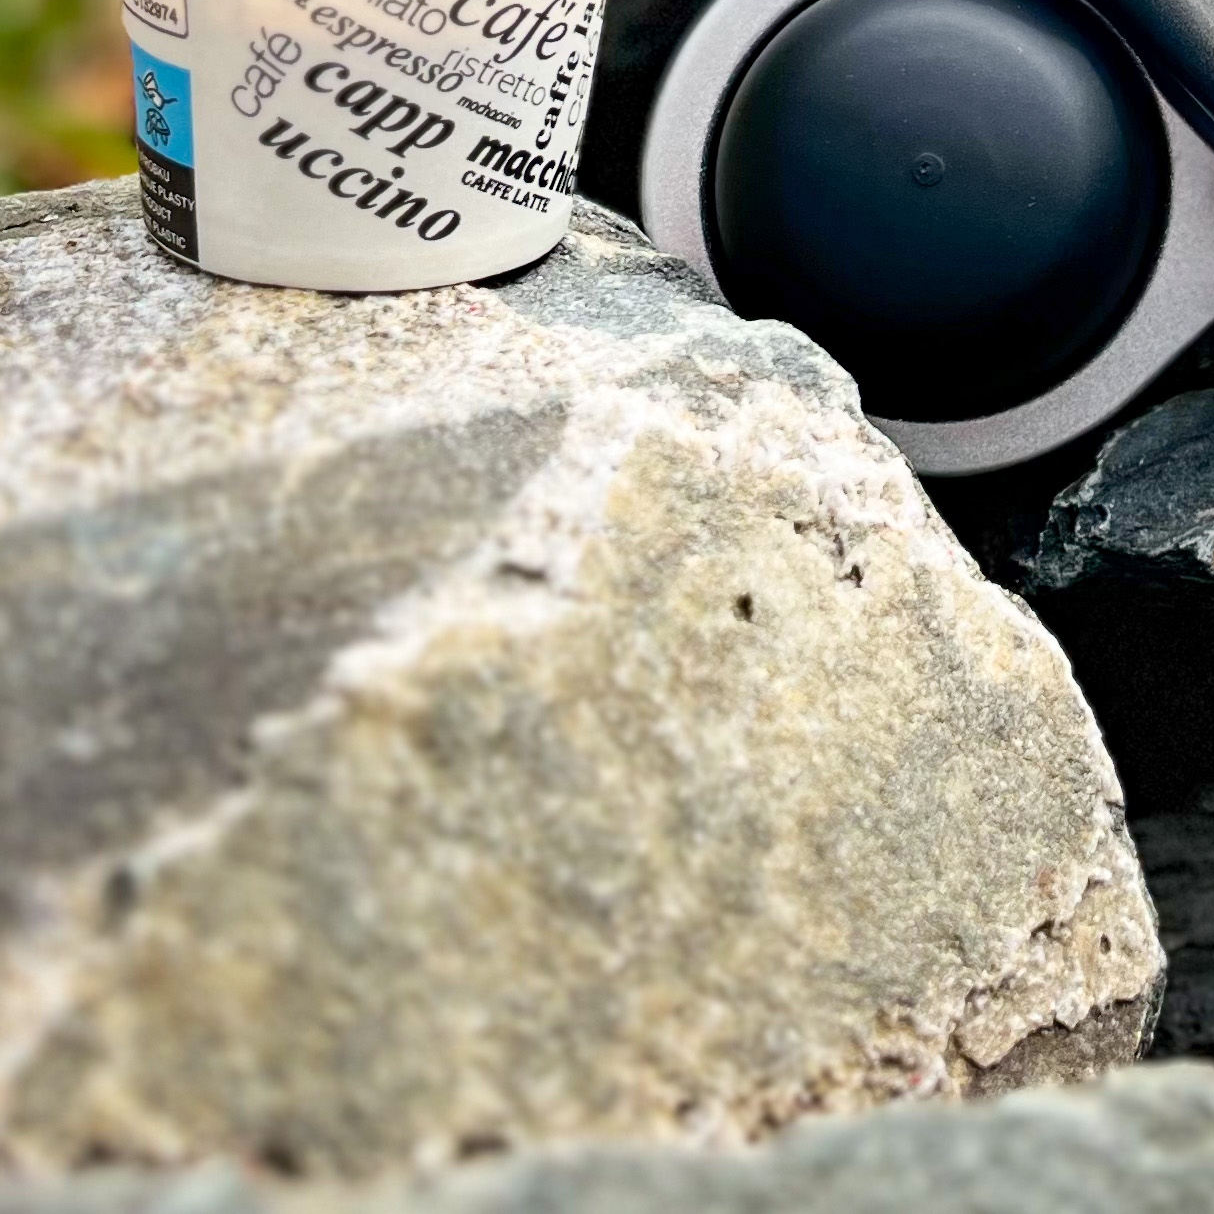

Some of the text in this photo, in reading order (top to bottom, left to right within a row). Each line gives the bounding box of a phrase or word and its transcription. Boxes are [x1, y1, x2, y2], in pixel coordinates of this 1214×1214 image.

[231, 26, 303, 118] café
[310, 5, 464, 92] espresso
[443, 46, 547, 106] ristretto
[304, 61, 456, 158] capp
[456, 96, 522, 129] mochaccino
[157, 184, 196, 212] PLASTY
[259, 116, 462, 241] uccino
[461, 170, 551, 213] CAFFE LATTE
